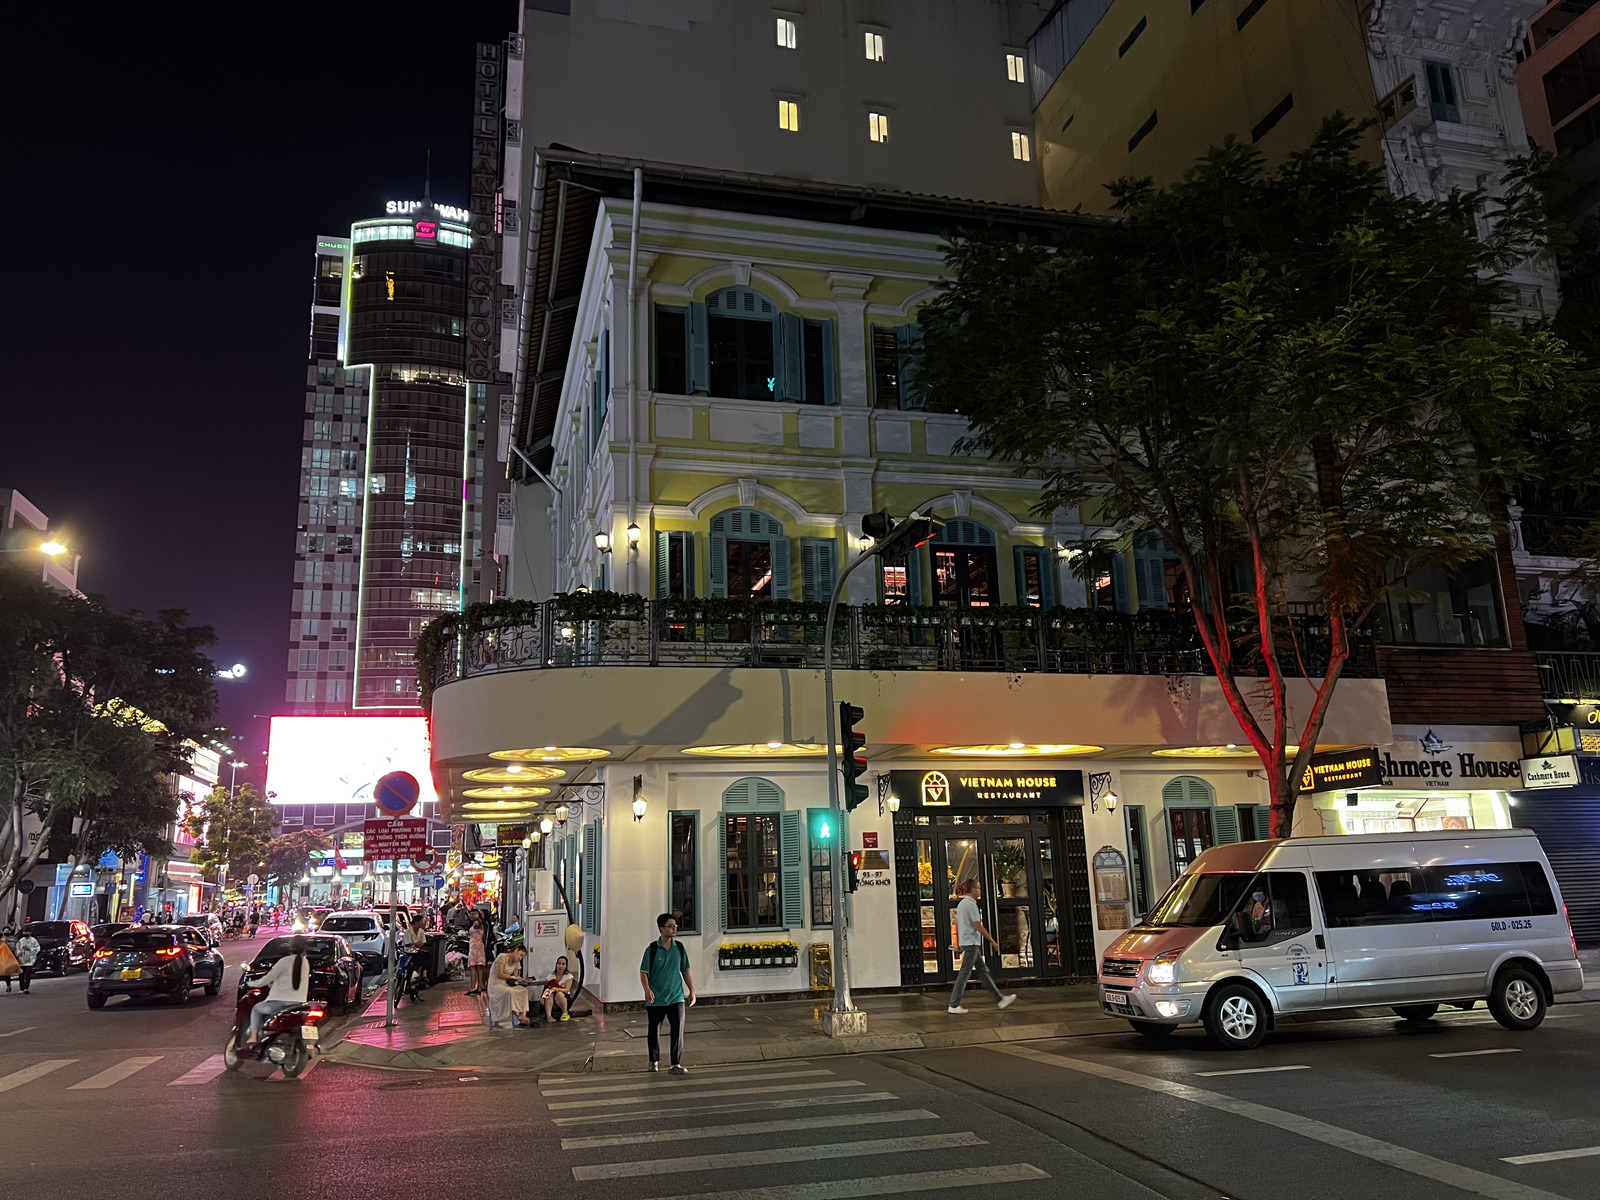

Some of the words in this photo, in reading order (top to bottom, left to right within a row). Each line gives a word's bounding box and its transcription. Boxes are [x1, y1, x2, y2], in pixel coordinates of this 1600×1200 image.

[480, 44, 498, 135] HOTEL
[469, 197, 494, 296] HOANG
[467, 298, 491, 380] LONG
[1313, 762, 1346, 774] VIETNAM
[1345, 758, 1372, 770] HOUSE
[1379, 752, 1453, 778] shmere
[1456, 752, 1521, 778] House
[1323, 771, 1363, 782] RESTAURANT
[1527, 771, 1554, 781] Cashmere
[1553, 770, 1571, 779] House
[960, 777, 1014, 788] VIETNAM
[1016, 777, 1057, 788] HOUSE
[387, 819, 404, 827] CẤM
[1491, 921, 1507, 931] 60LD
[1511, 920, 1532, 930] 025.26
